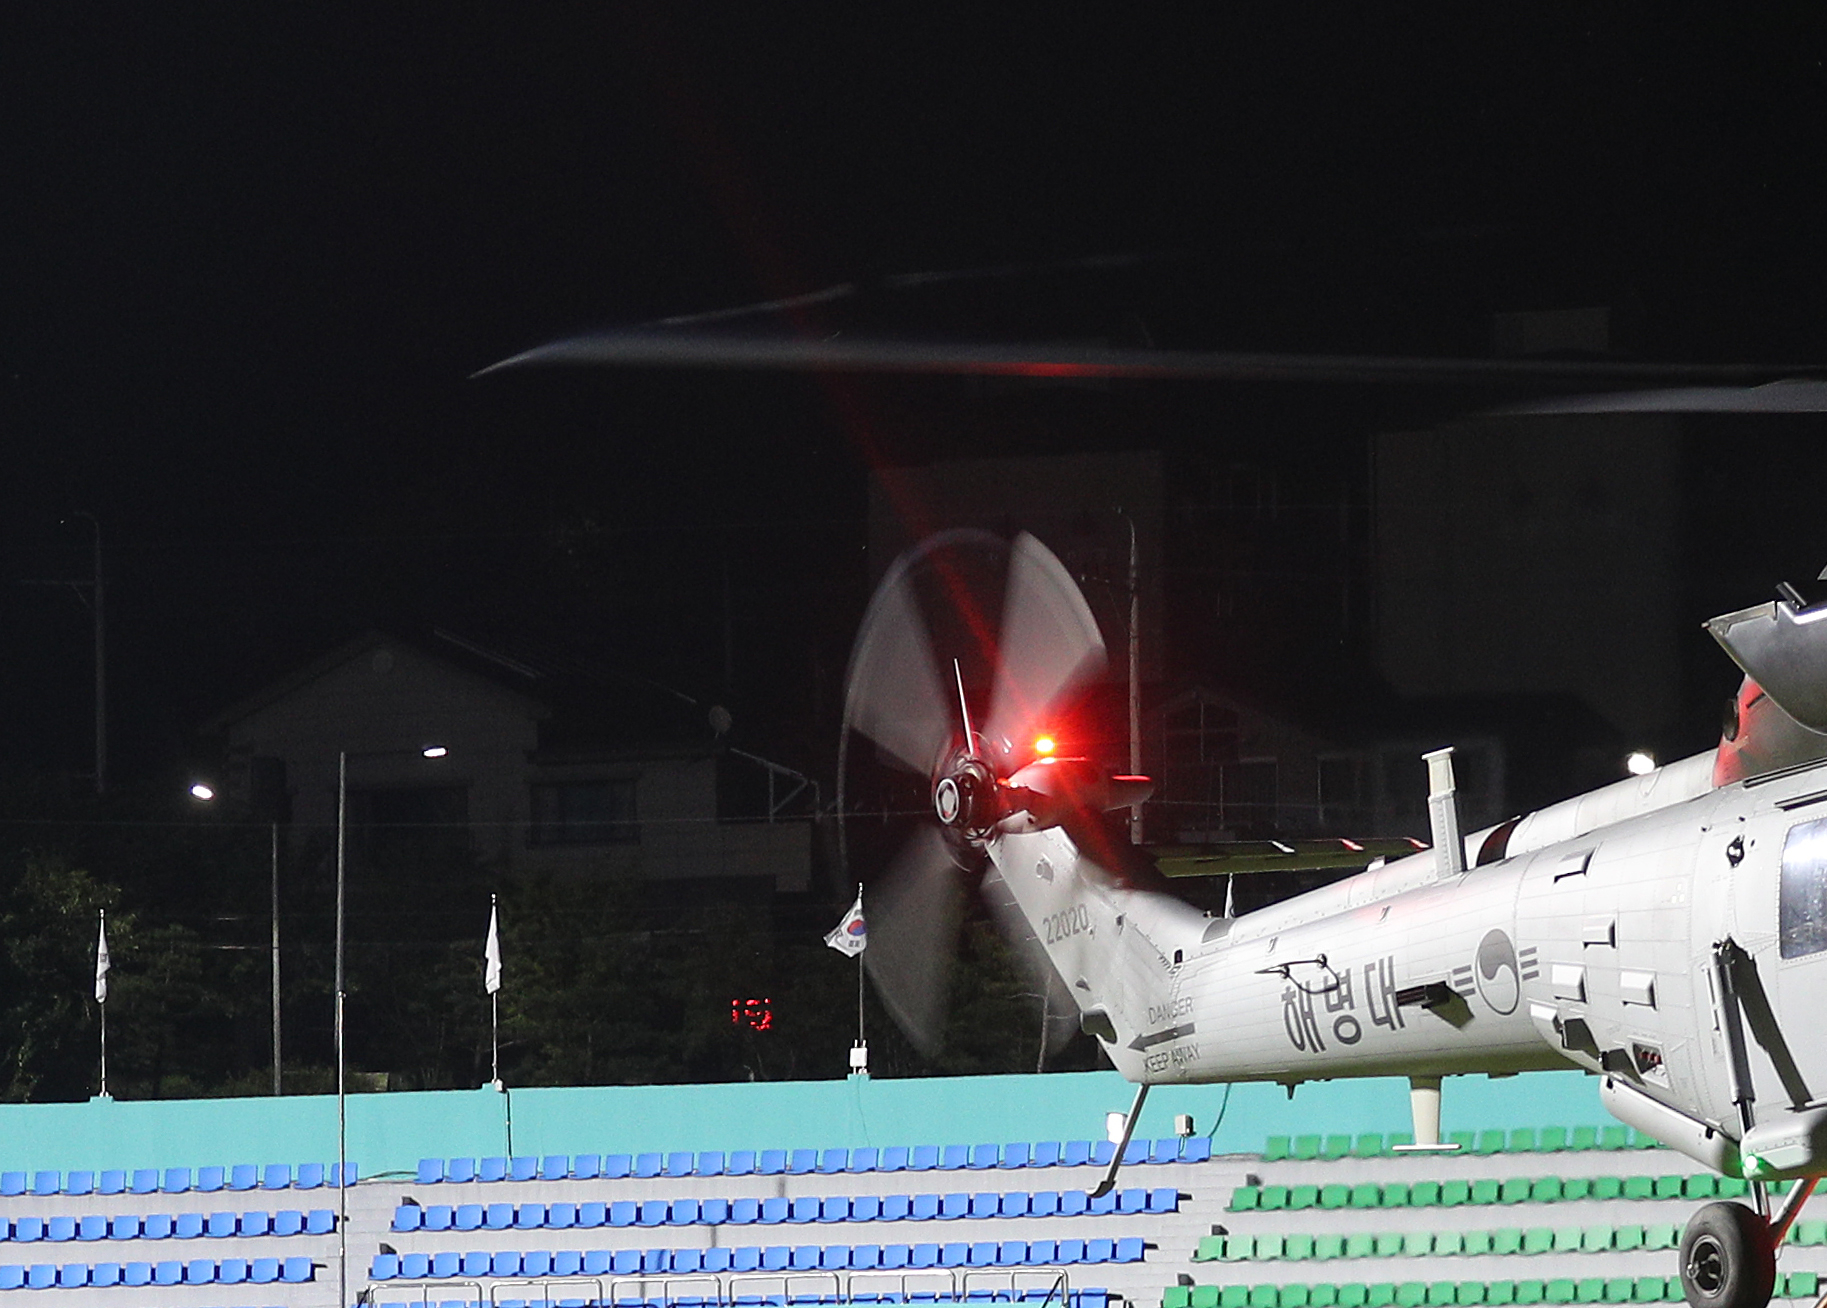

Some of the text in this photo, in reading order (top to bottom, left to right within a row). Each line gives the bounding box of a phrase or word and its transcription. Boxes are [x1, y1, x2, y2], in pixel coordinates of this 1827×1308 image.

[1042, 904, 1090, 945] 22020
[1148, 996, 1194, 1026] DANGER
[1281, 955, 1406, 1054] 해병대
[1144, 1042, 1201, 1074] KEEP AWAY
